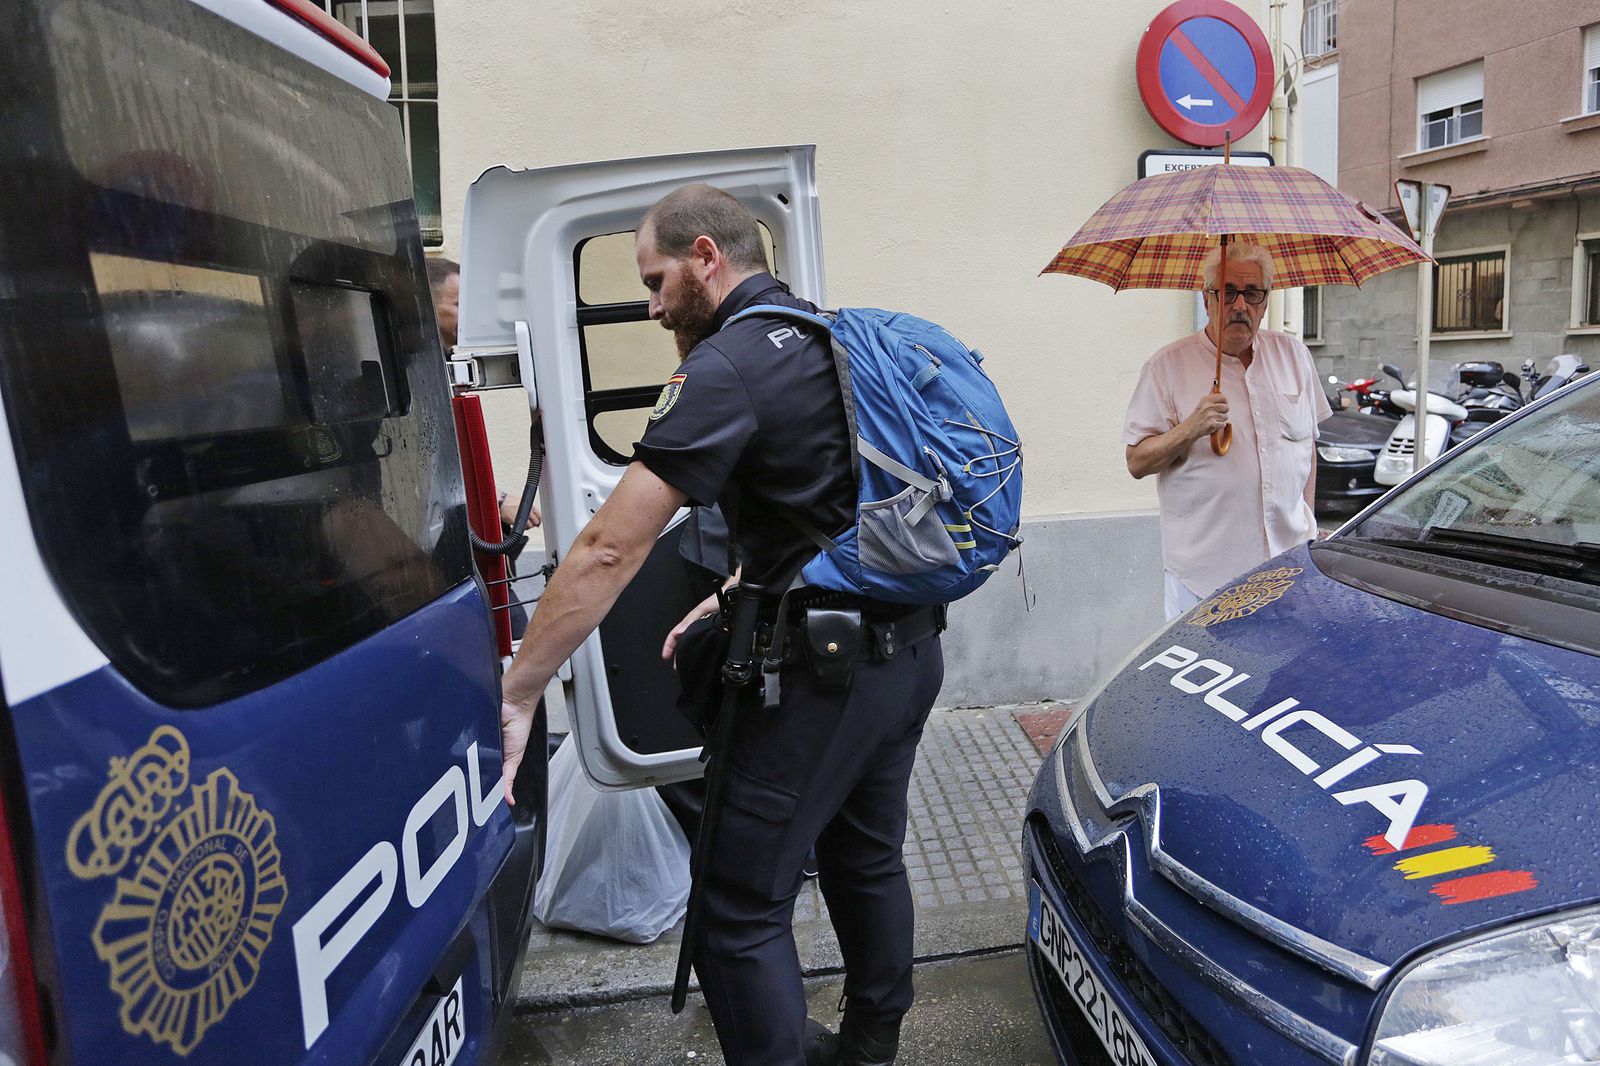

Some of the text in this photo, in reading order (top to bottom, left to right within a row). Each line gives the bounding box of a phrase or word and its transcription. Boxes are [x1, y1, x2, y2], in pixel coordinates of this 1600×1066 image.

[1138, 645, 1429, 851] POLICÍA
[168, 837, 228, 894] NACIONAL
[233, 843, 249, 863] DE
[292, 740, 505, 1051] POL
